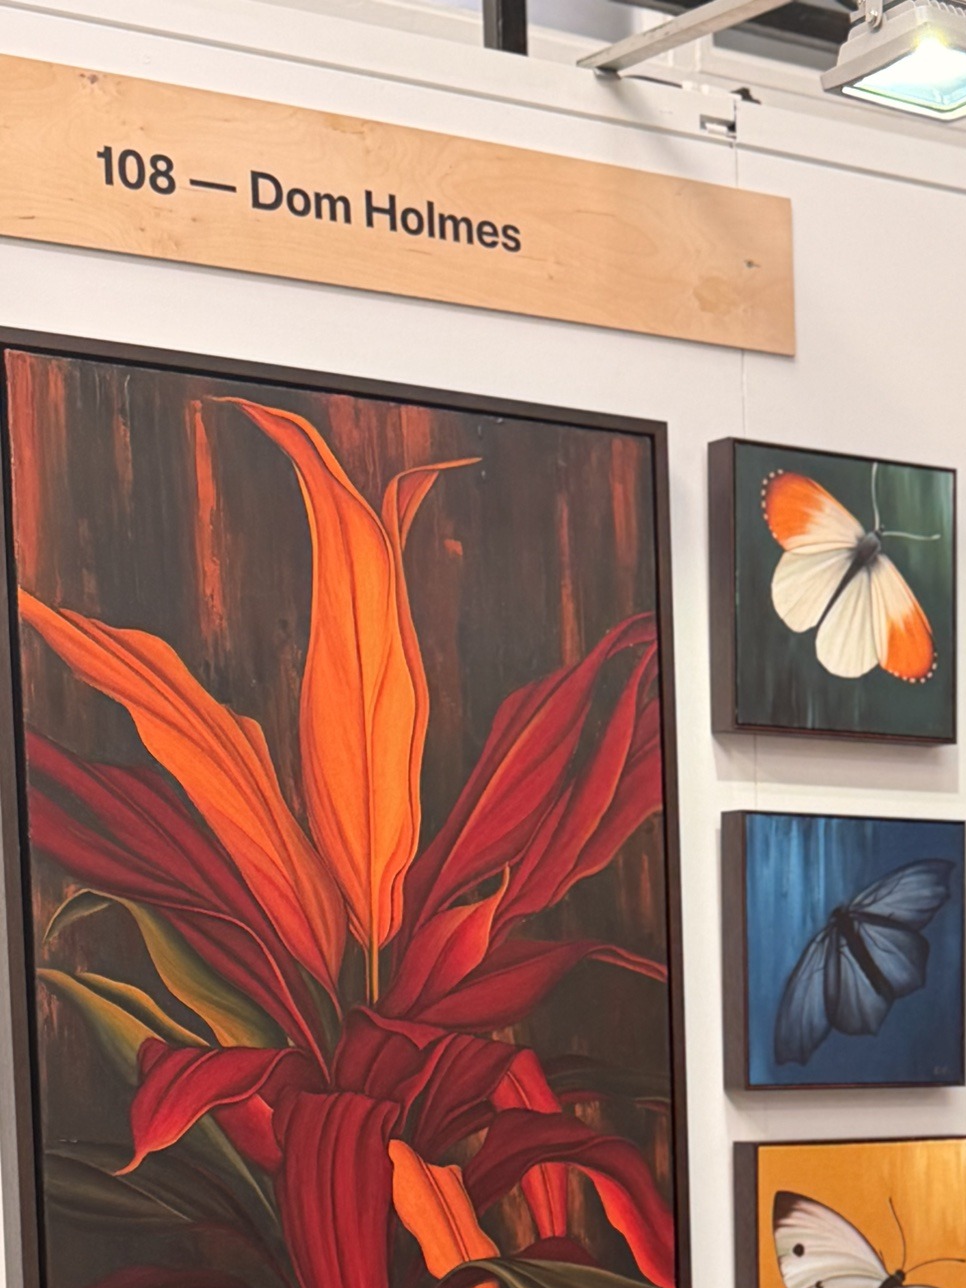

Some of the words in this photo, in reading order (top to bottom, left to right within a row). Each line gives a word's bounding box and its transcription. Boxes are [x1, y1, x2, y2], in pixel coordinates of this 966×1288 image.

[97, 145, 176, 195] 108
[250, 170, 352, 224] Dom
[365, 190, 521, 252] Holmes
